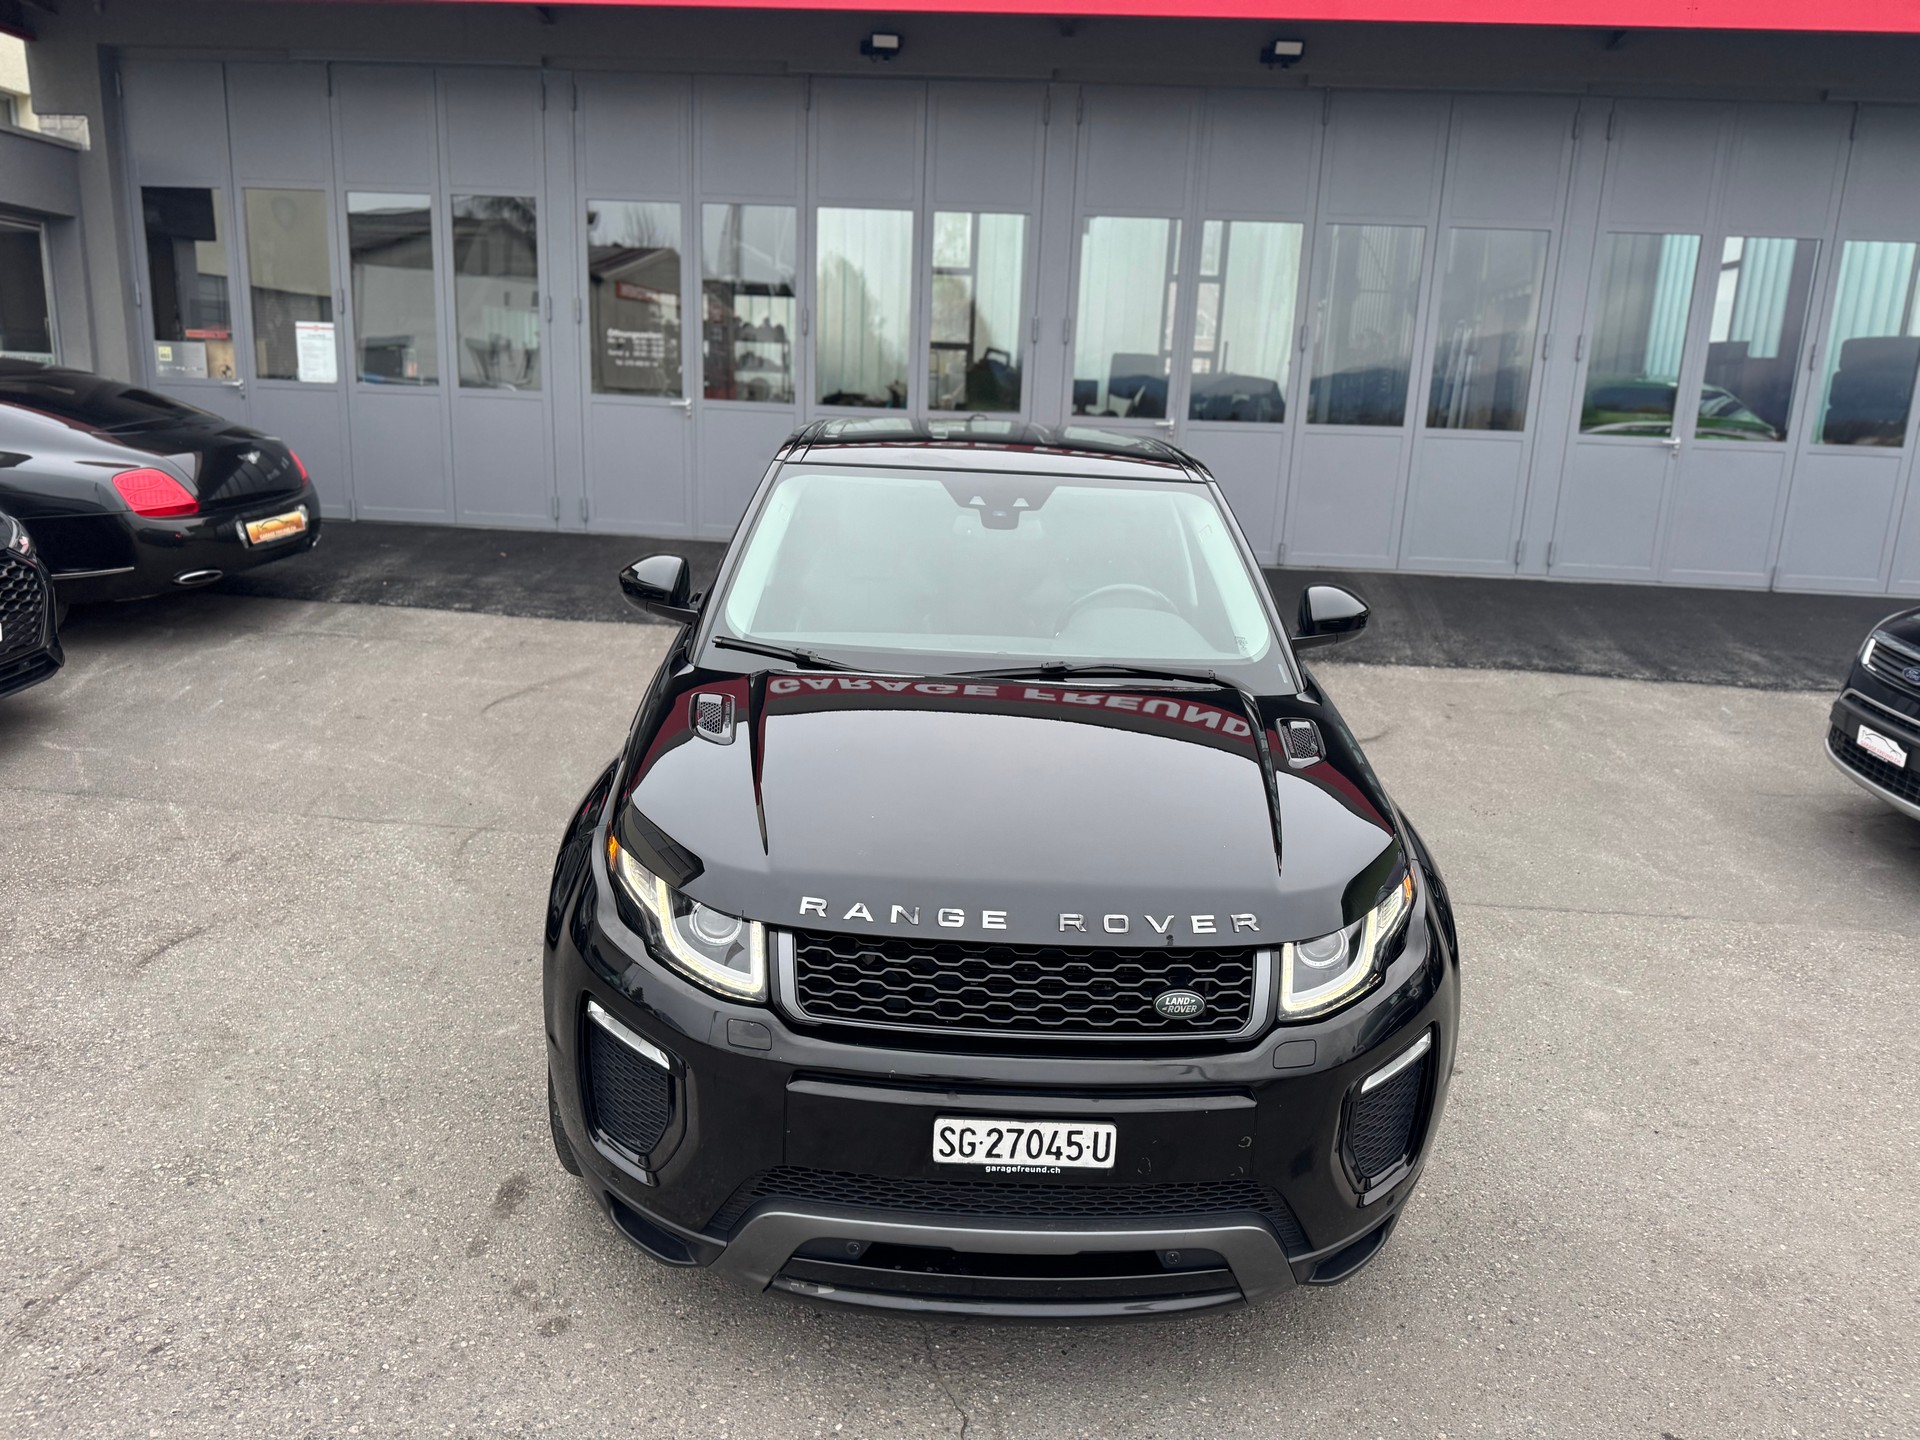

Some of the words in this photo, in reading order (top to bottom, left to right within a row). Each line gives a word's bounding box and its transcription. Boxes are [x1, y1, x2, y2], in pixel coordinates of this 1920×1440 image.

[799, 896, 1008, 930] RANGE
[1058, 913, 1261, 935] ROVER
[1165, 997, 1191, 1005] LAND
[1167, 1005, 1198, 1013] ROVER
[985, 1165, 1061, 1175] garagefreund.ch
